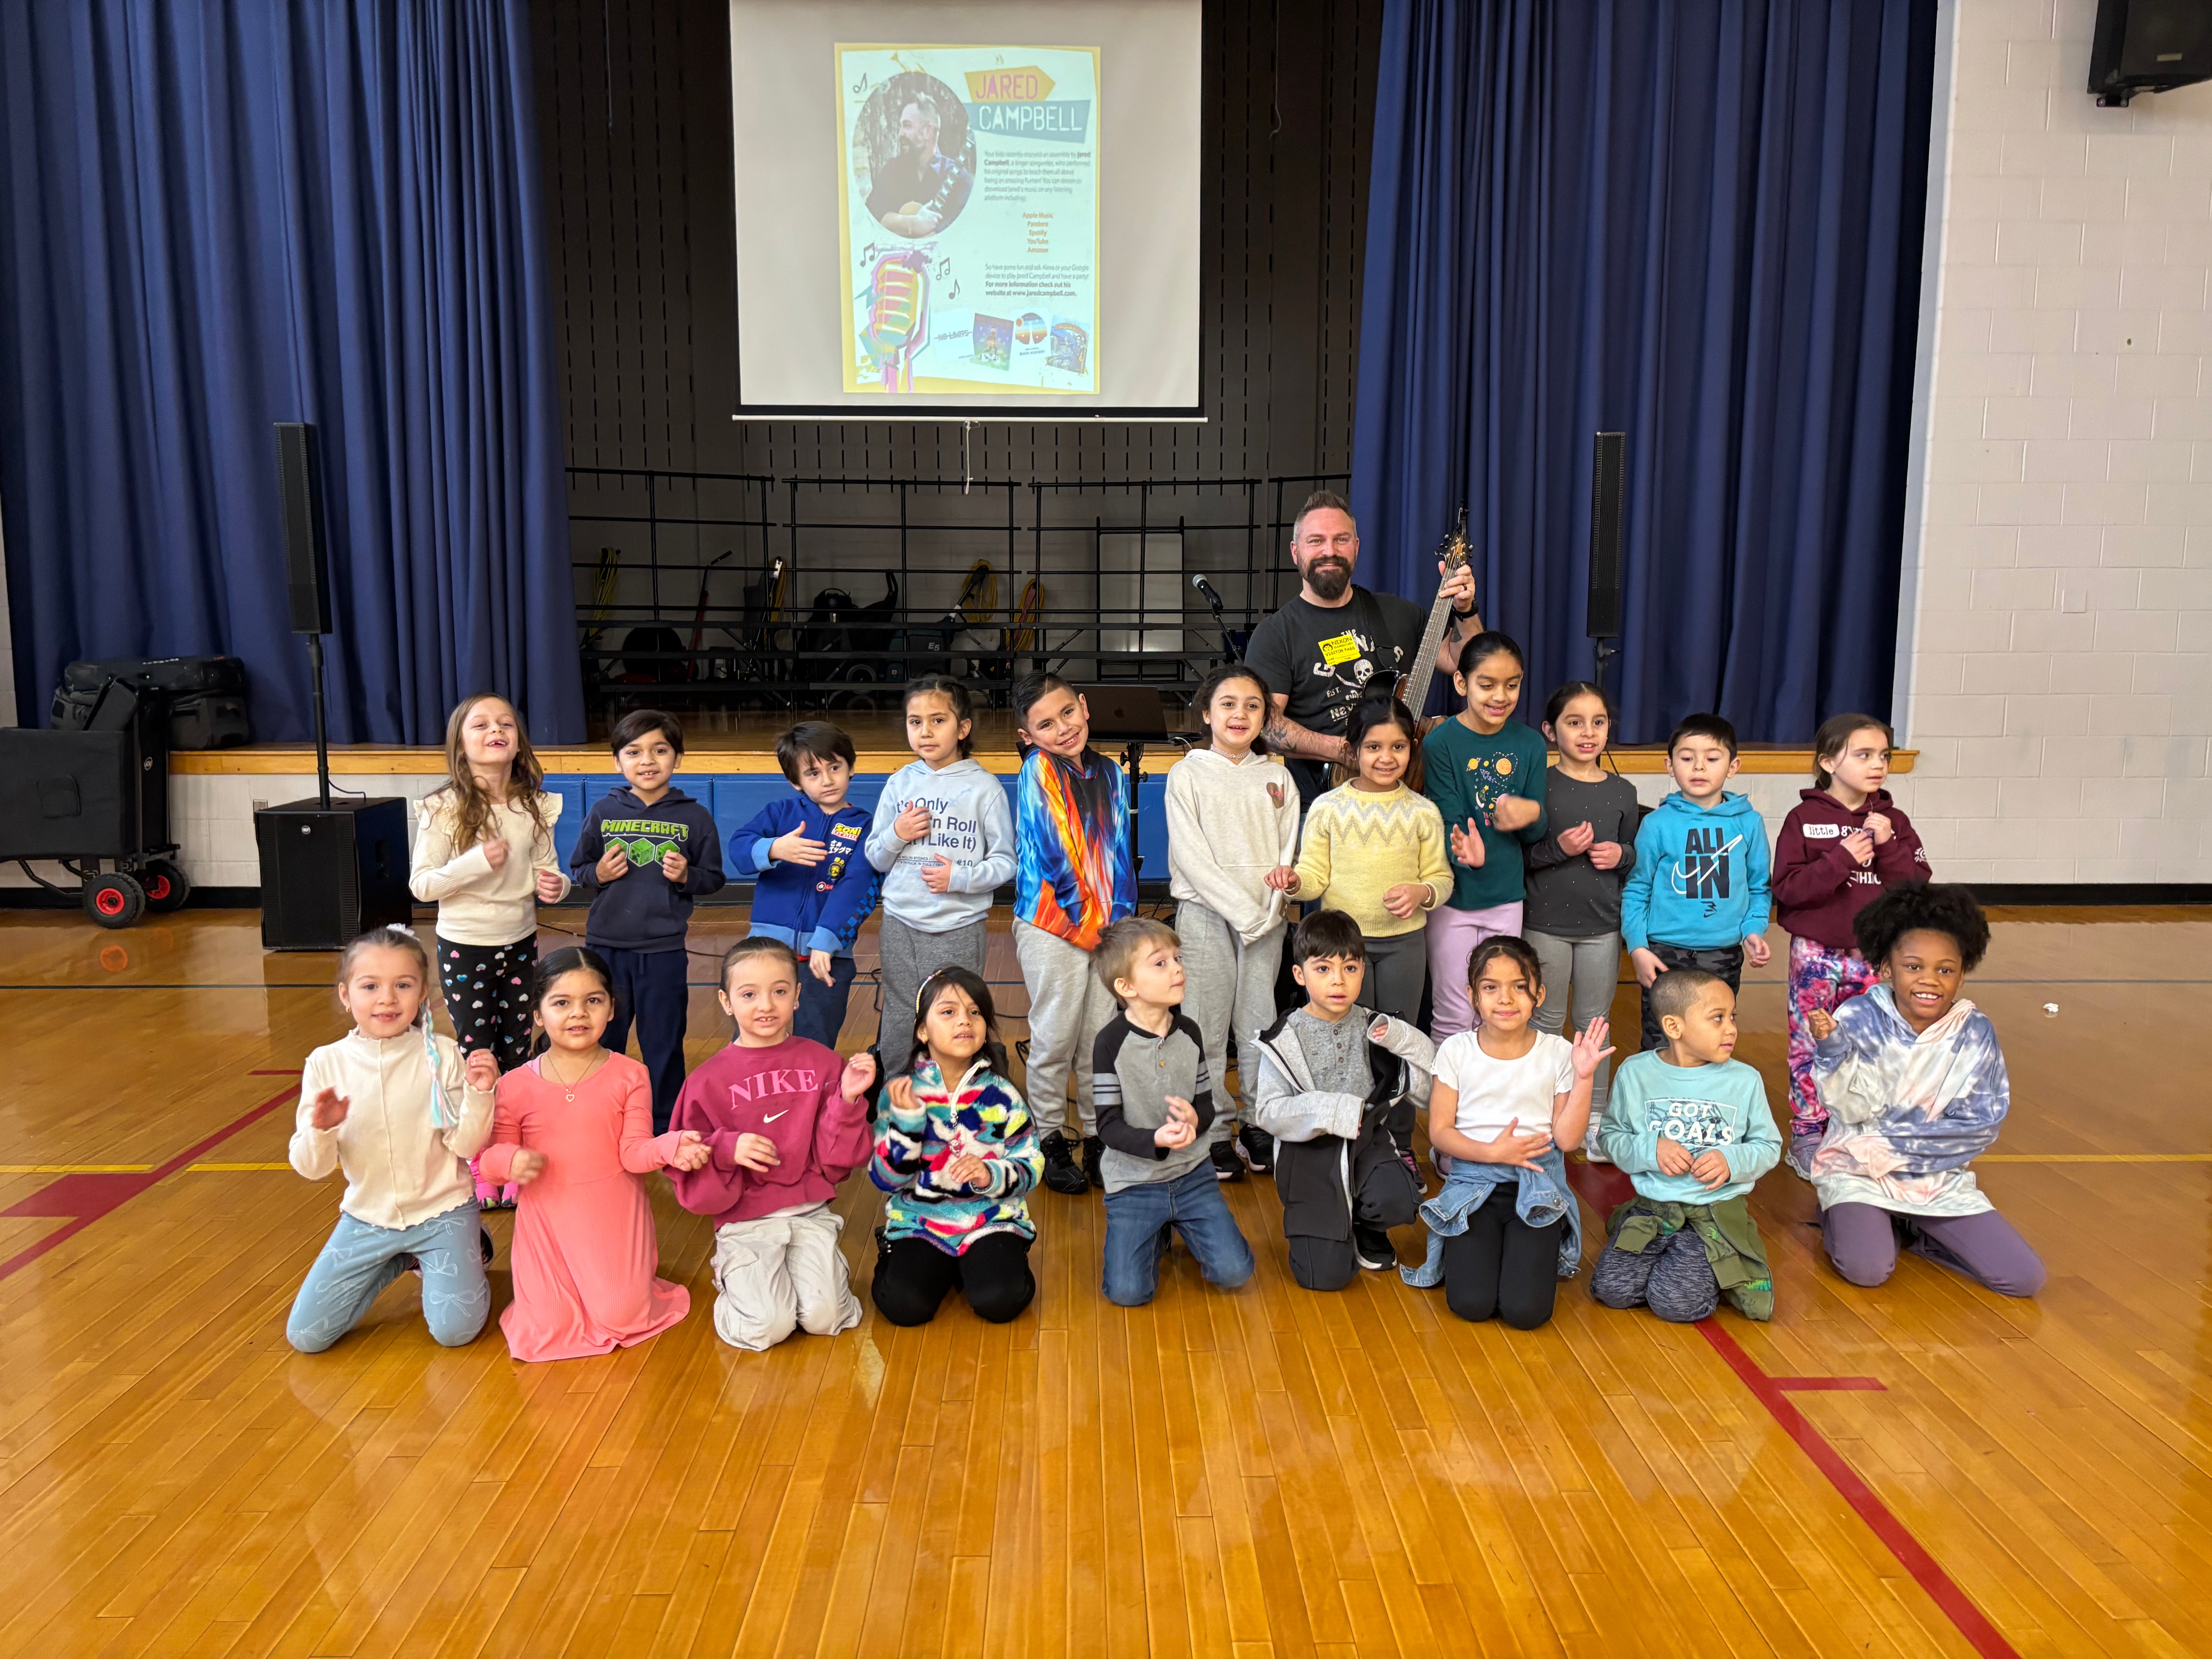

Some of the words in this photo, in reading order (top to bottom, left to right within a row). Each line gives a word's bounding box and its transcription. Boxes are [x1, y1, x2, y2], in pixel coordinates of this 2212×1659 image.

[975, 74, 1038, 100] JARED
[979, 105, 1082, 131] CAMPBELL
[928, 642, 940, 651] E5
[1331, 636, 1352, 646] NIXON
[1325, 649, 1343, 657] VISITOR
[915, 797, 949, 814] Only
[601, 821, 689, 837] MINECRAFT
[947, 816, 977, 833] Roll
[1809, 826, 1834, 835] little
[928, 833, 959, 848] Like
[963, 836, 976, 853] It)
[1685, 827, 1729, 854] ALL
[1685, 855, 1730, 899] IN
[728, 1069, 819, 1110] NIKE
[1669, 1102, 1712, 1119] GOT
